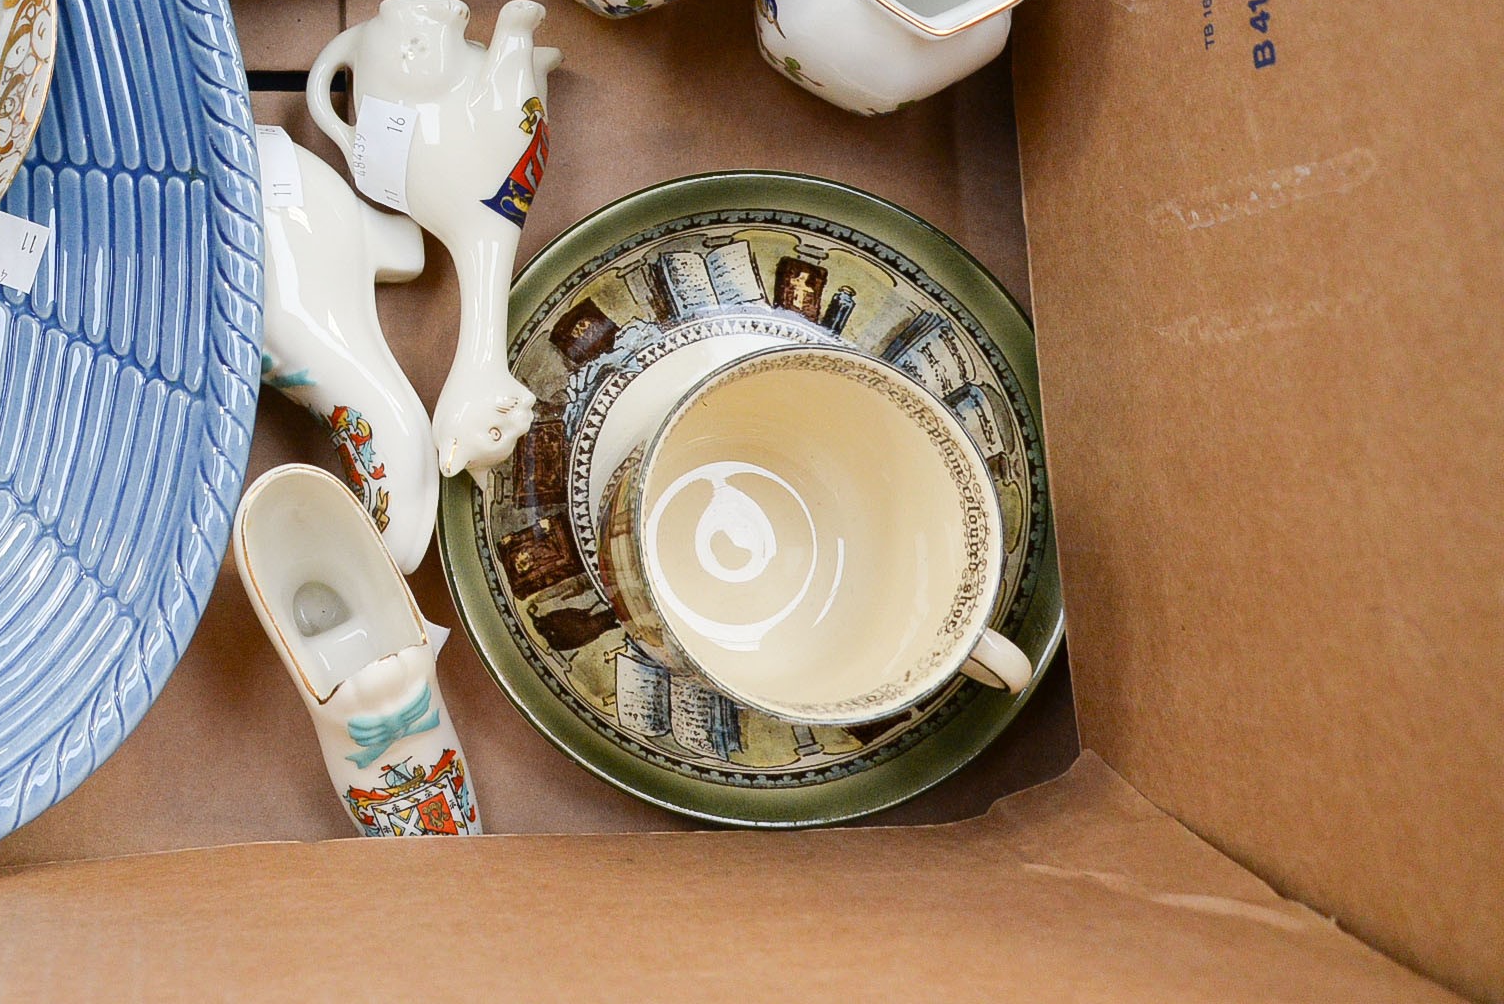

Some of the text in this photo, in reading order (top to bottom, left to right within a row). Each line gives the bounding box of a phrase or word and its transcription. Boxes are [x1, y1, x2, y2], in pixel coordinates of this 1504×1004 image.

[1203, 22, 1215, 50] TB
[1253, 39, 1276, 69] B
[386, 116, 406, 133] 16
[353, 133, 367, 177] 48439
[384, 189, 400, 203] 11
[21, 232, 37, 254] 11
